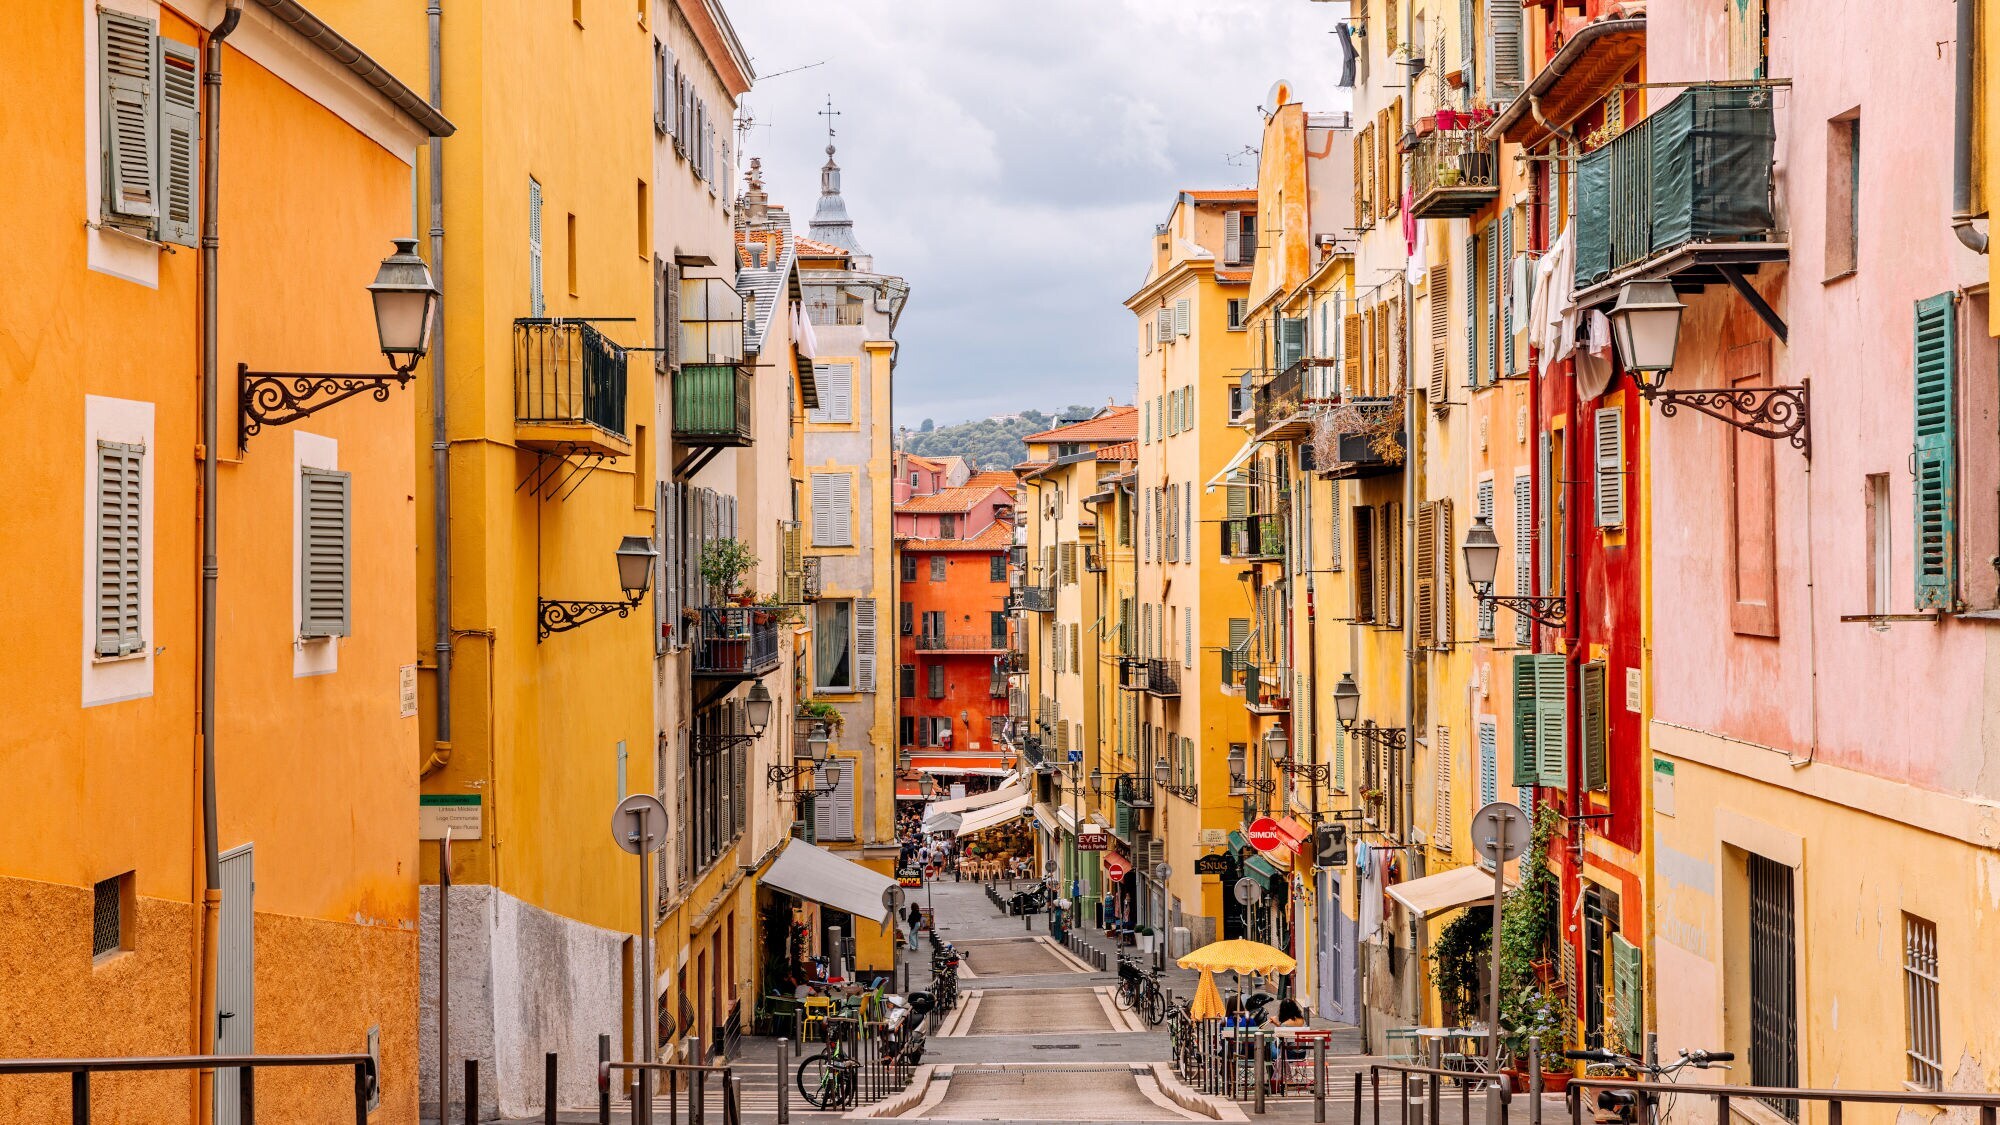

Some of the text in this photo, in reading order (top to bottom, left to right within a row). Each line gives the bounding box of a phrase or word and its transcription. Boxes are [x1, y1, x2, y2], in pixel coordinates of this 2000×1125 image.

[1078, 835, 1107, 843] EVEN
[1249, 831, 1277, 839] SIMON
[1199, 860, 1228, 871] SNUG
